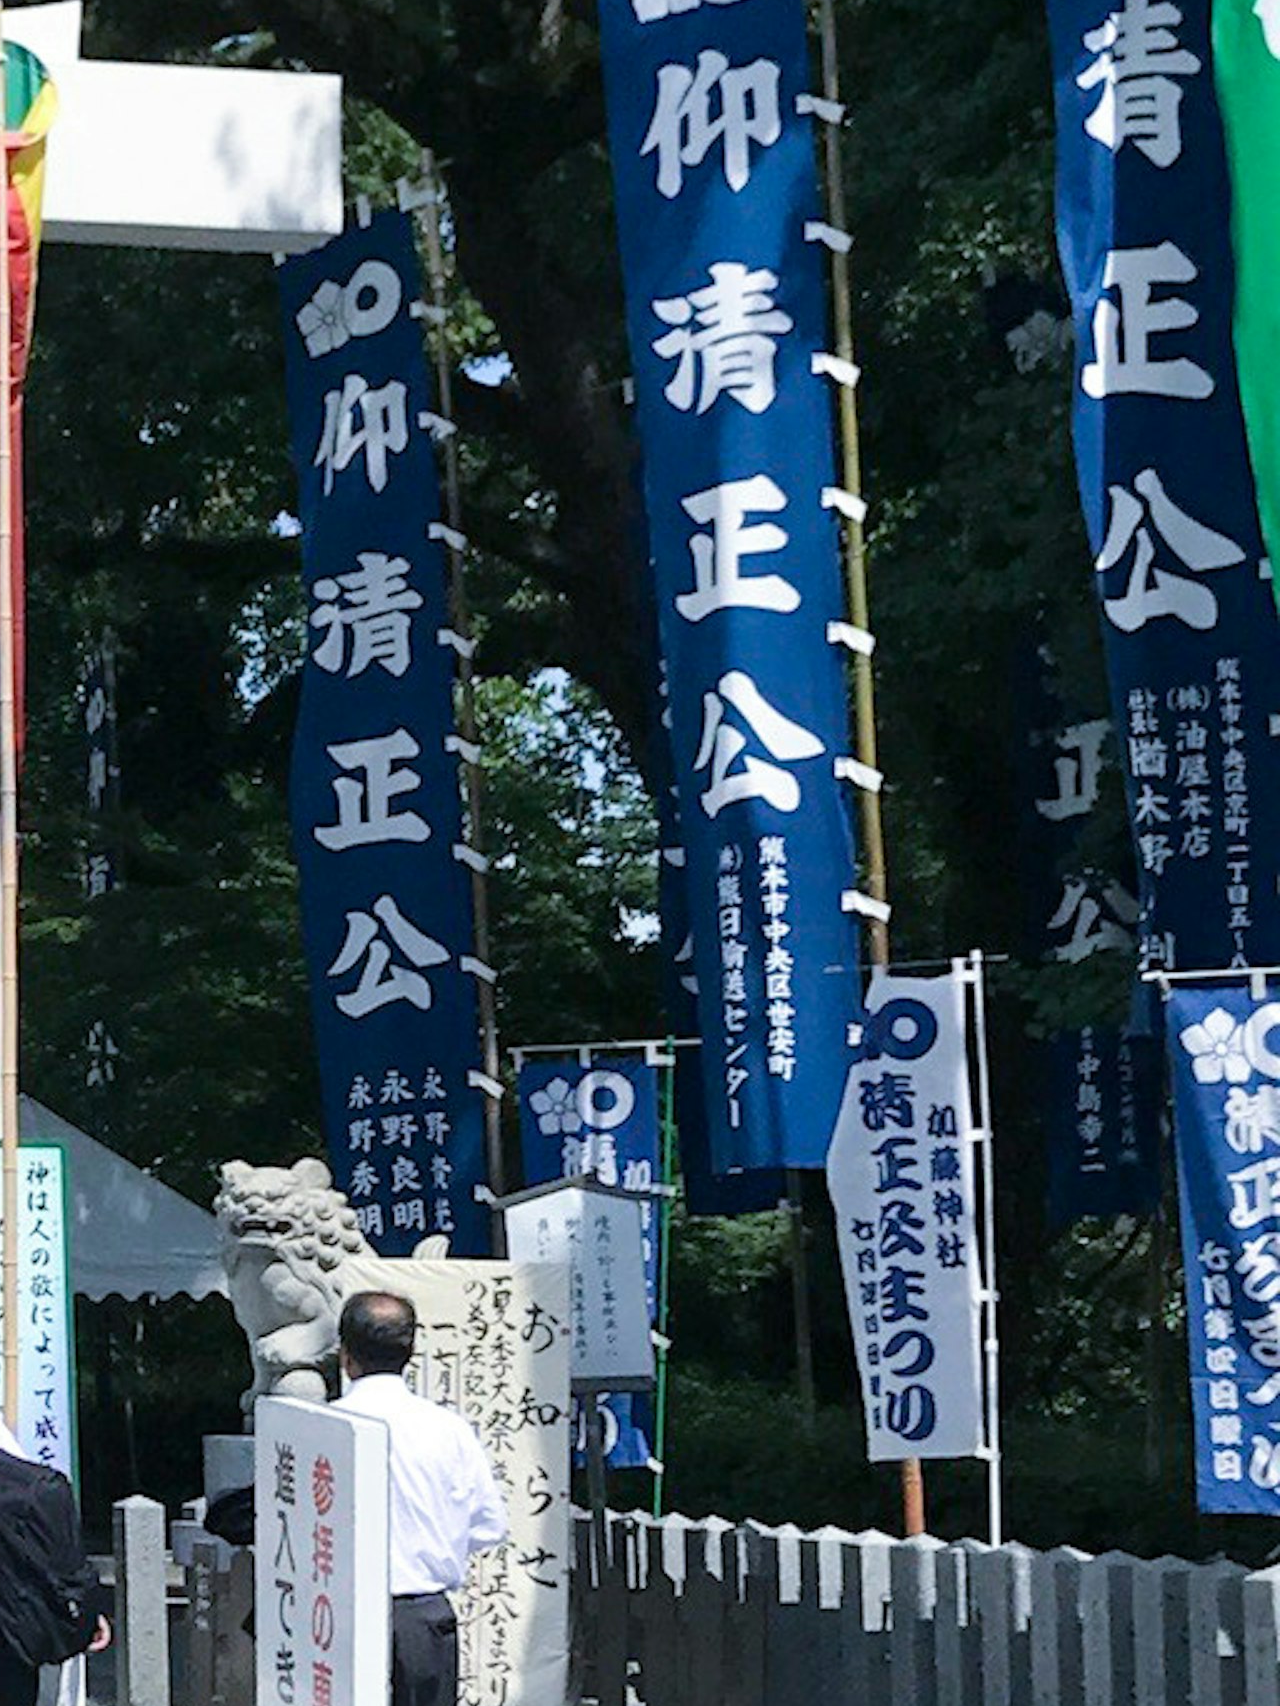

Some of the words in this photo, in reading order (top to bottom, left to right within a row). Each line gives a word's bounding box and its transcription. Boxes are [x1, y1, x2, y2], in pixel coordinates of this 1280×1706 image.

[640, 48, 827, 819] 仰清正公
[311, 373, 450, 1022] 仰清正公
[347, 1075, 384, 1236] 永野秀明
[380, 1069, 426, 1231] 永野良明
[860, 1073, 938, 1442] 清正公まつり
[927, 1104, 968, 1269] 加藤神社
[517, 1302, 561, 1588] お知らせ
